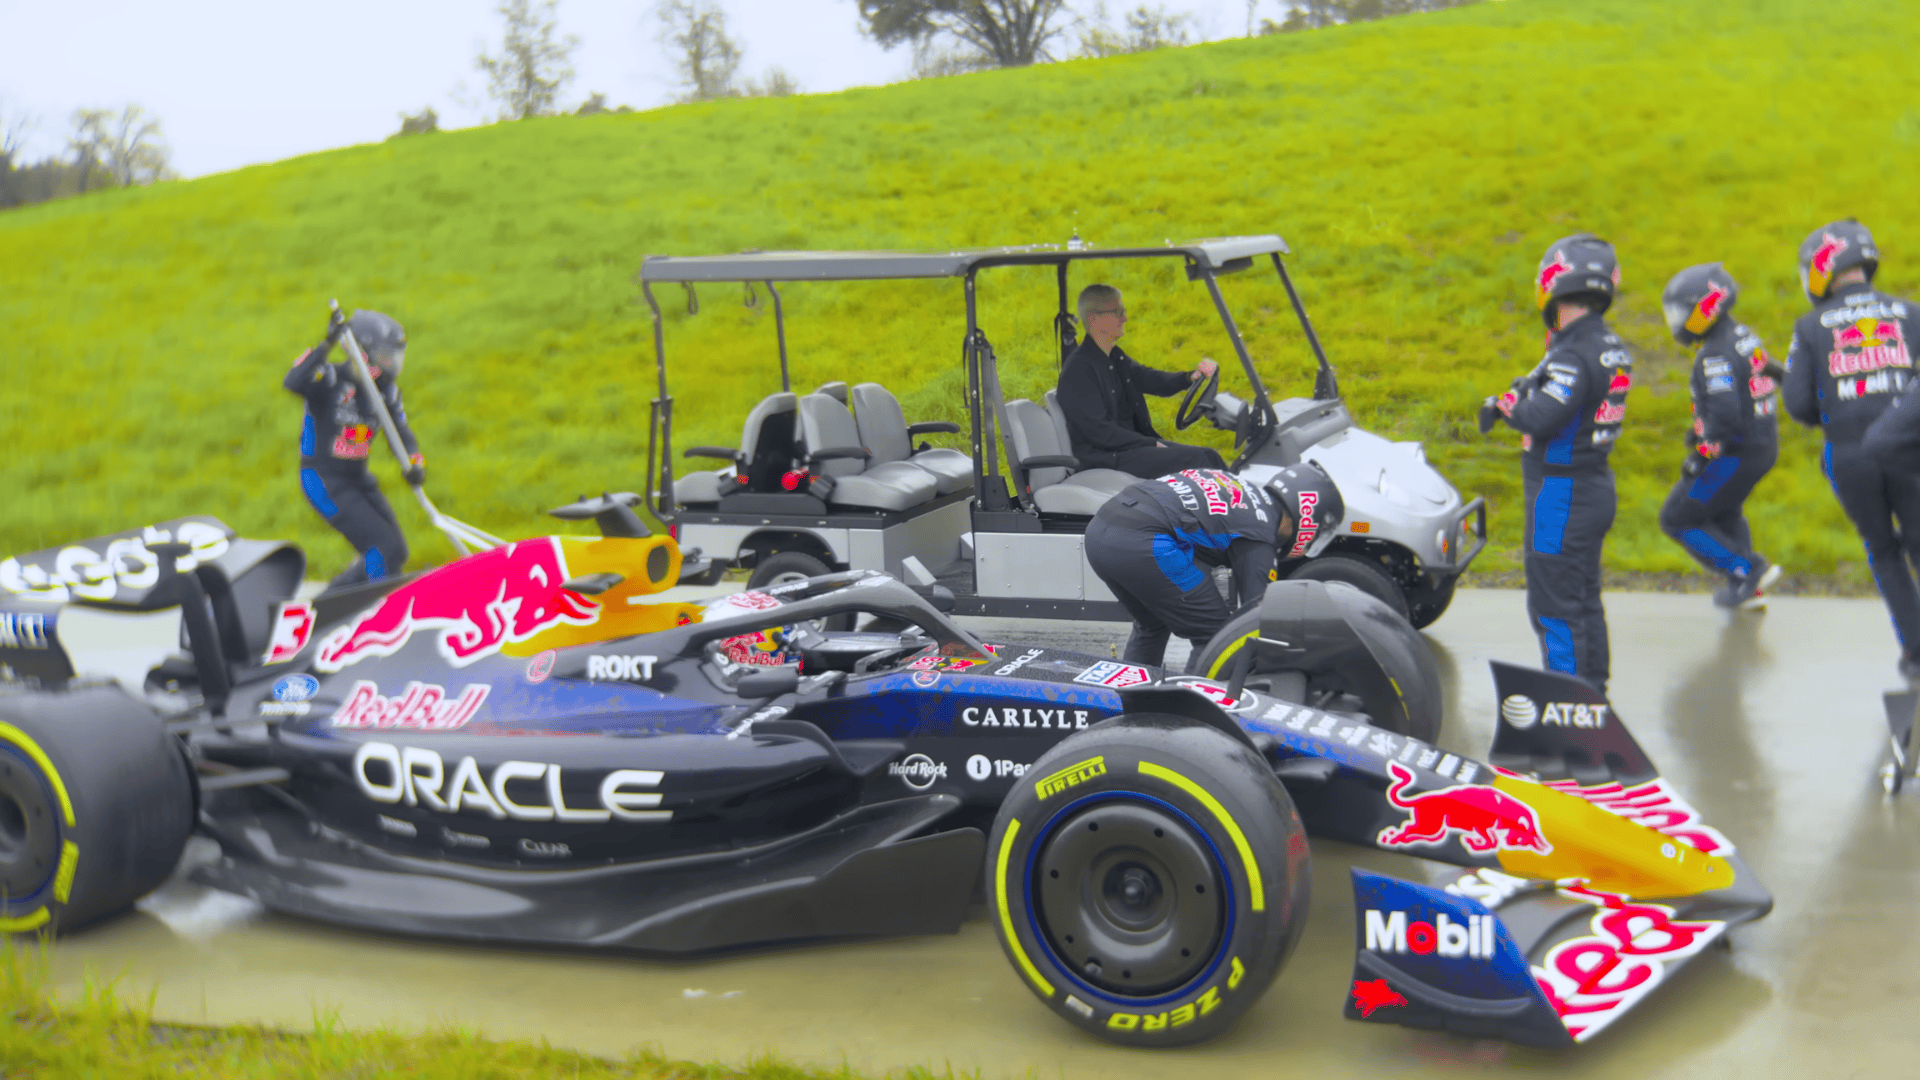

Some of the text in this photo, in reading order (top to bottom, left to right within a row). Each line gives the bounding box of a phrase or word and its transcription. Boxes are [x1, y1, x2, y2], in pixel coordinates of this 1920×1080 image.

[1298, 491, 1319, 530] Red
[588, 654, 658, 680] ROKT
[1080, 662, 1119, 683] TAG
[962, 707, 1089, 729] CARLYLE
[1541, 702, 1608, 728] AT&T
[355, 741, 674, 822] ORACLE
[889, 761, 948, 779] Hard Rock
[1035, 755, 1107, 800] PIRELLI
[1365, 909, 1497, 961] Mobil
[1106, 985, 1222, 1031] ZERO
